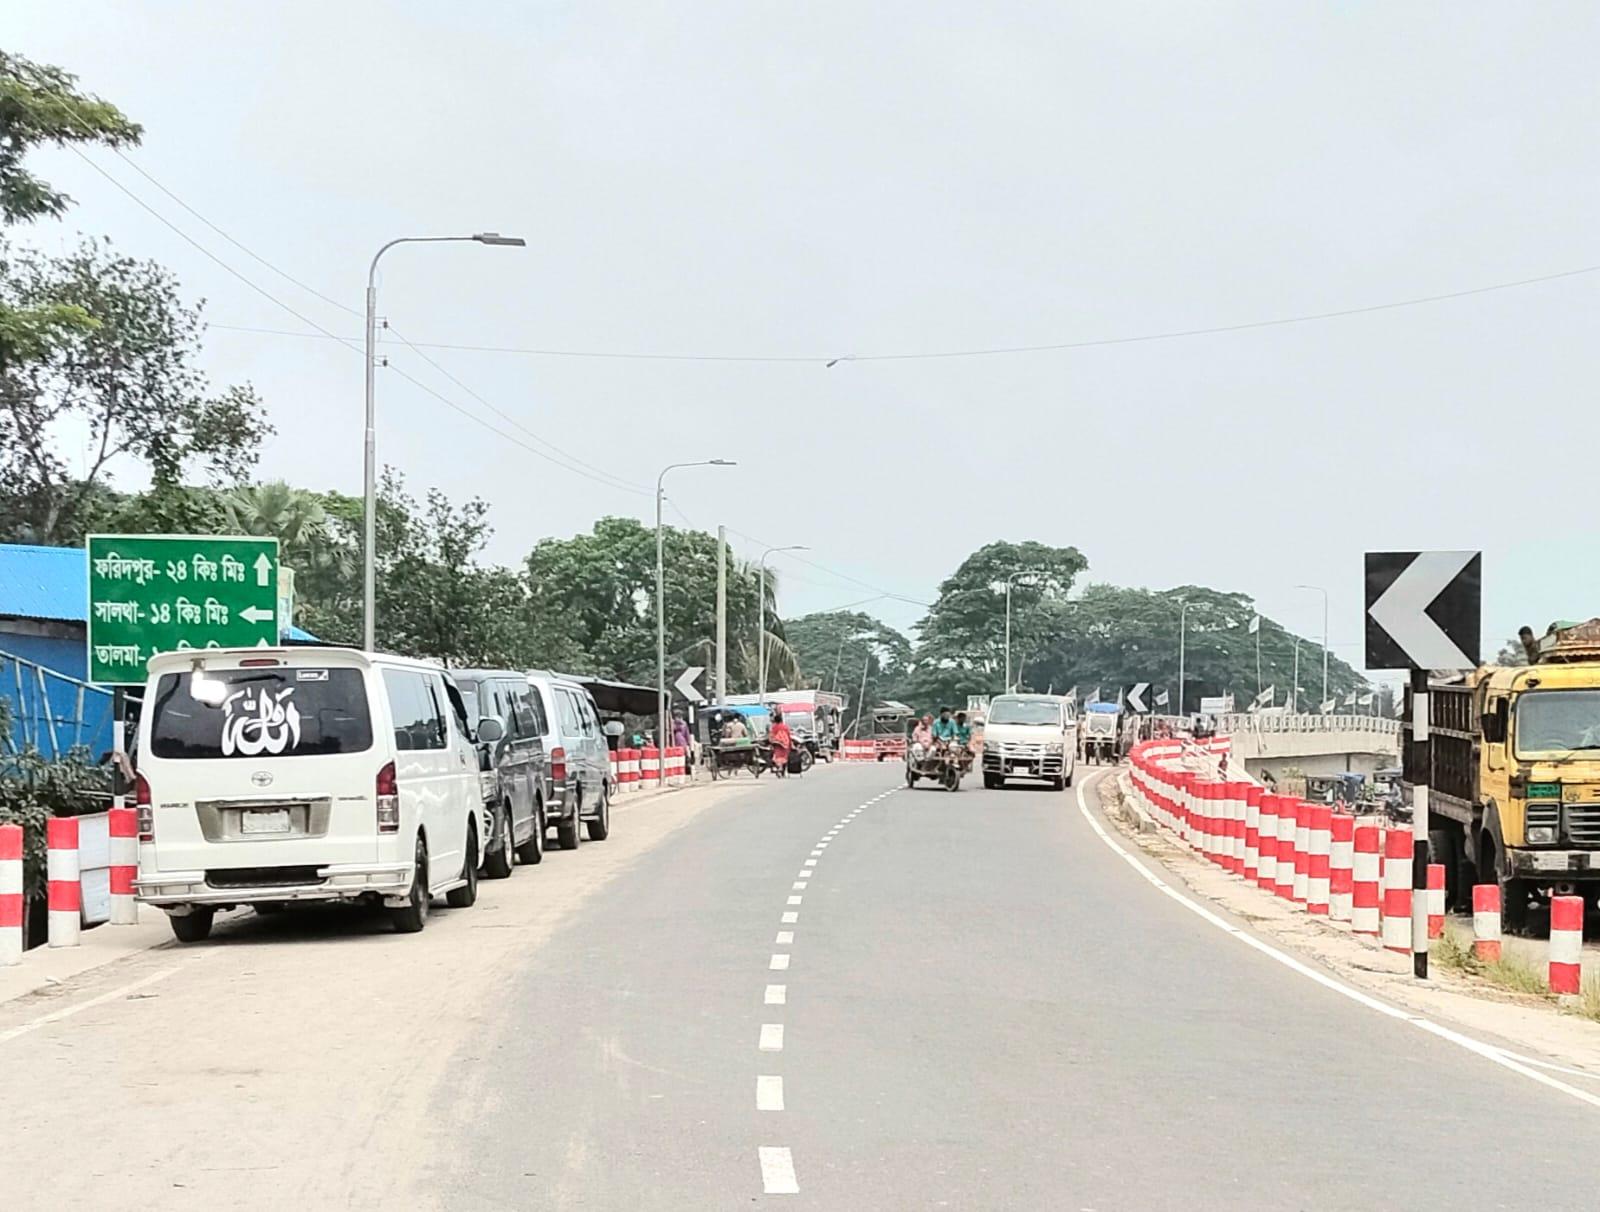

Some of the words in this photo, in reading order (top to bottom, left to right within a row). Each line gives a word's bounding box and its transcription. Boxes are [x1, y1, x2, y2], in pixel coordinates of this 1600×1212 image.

[92, 551, 161, 586] ফরিদপুর-
[166, 559, 188, 584] ২৪
[93, 599, 145, 624] সালথা-
[150, 602, 171, 625] ১৪
[94, 643, 147, 667] তালমা-
